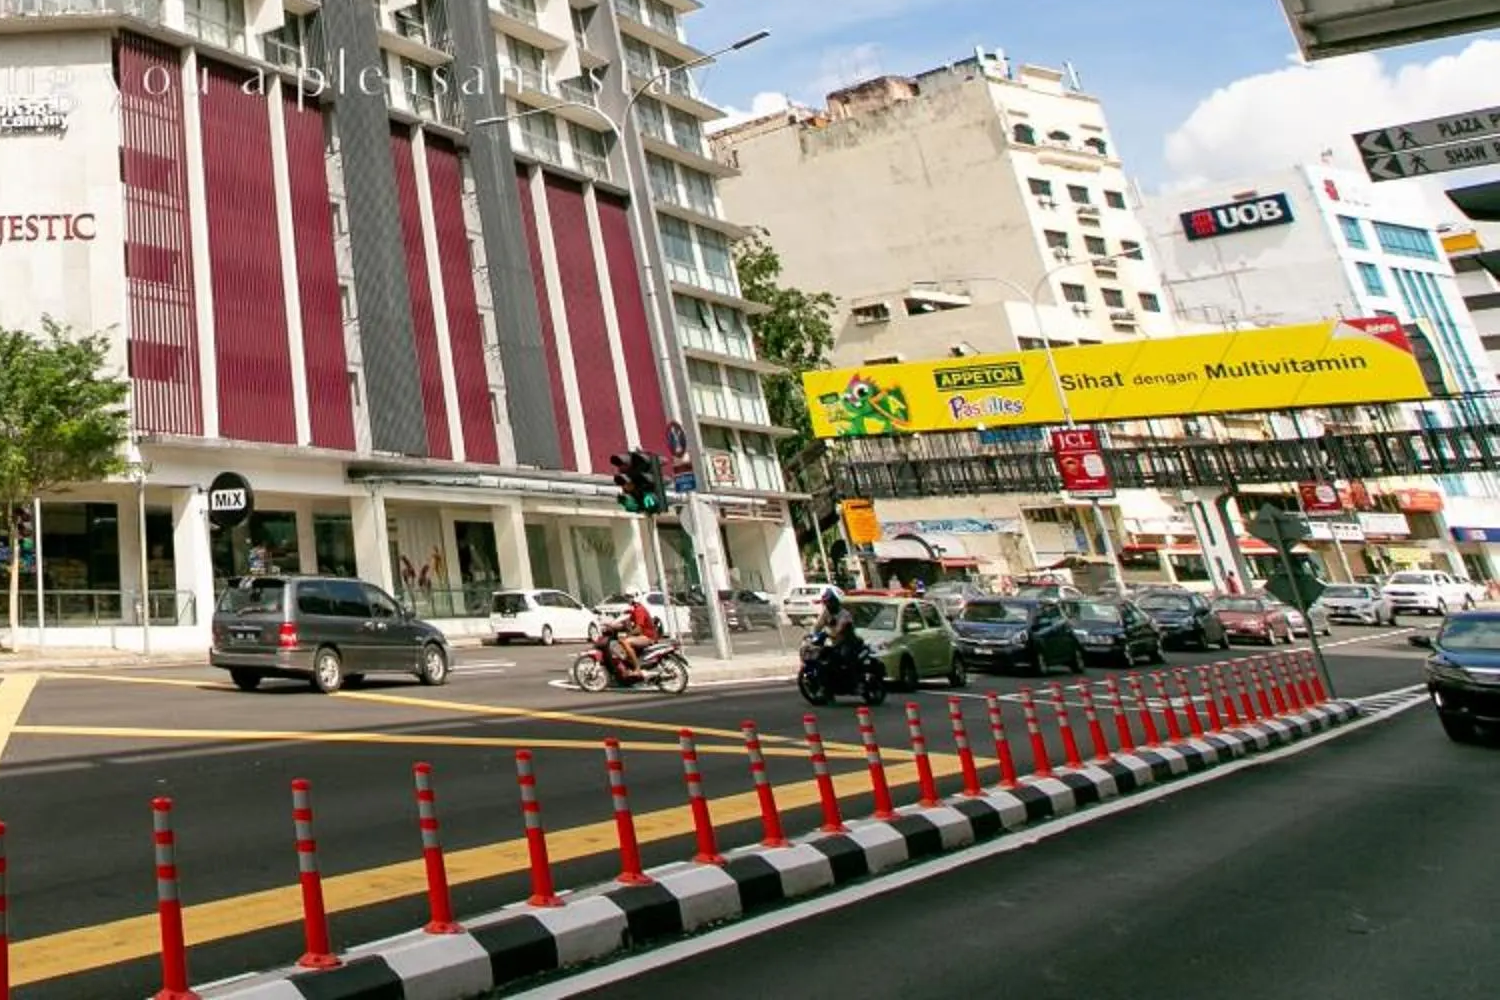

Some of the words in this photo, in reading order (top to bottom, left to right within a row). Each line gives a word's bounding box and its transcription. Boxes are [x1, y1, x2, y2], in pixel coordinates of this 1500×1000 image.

[1437, 116, 1487, 137] PLAZA
[1217, 198, 1283, 230] UOB
[940, 366, 1019, 387] APPETON
[1060, 371, 1125, 391] Sihat
[1132, 370, 1199, 387] dengan
[1203, 353, 1367, 381] Multivitamin
[215, 491, 243, 507] MiX
